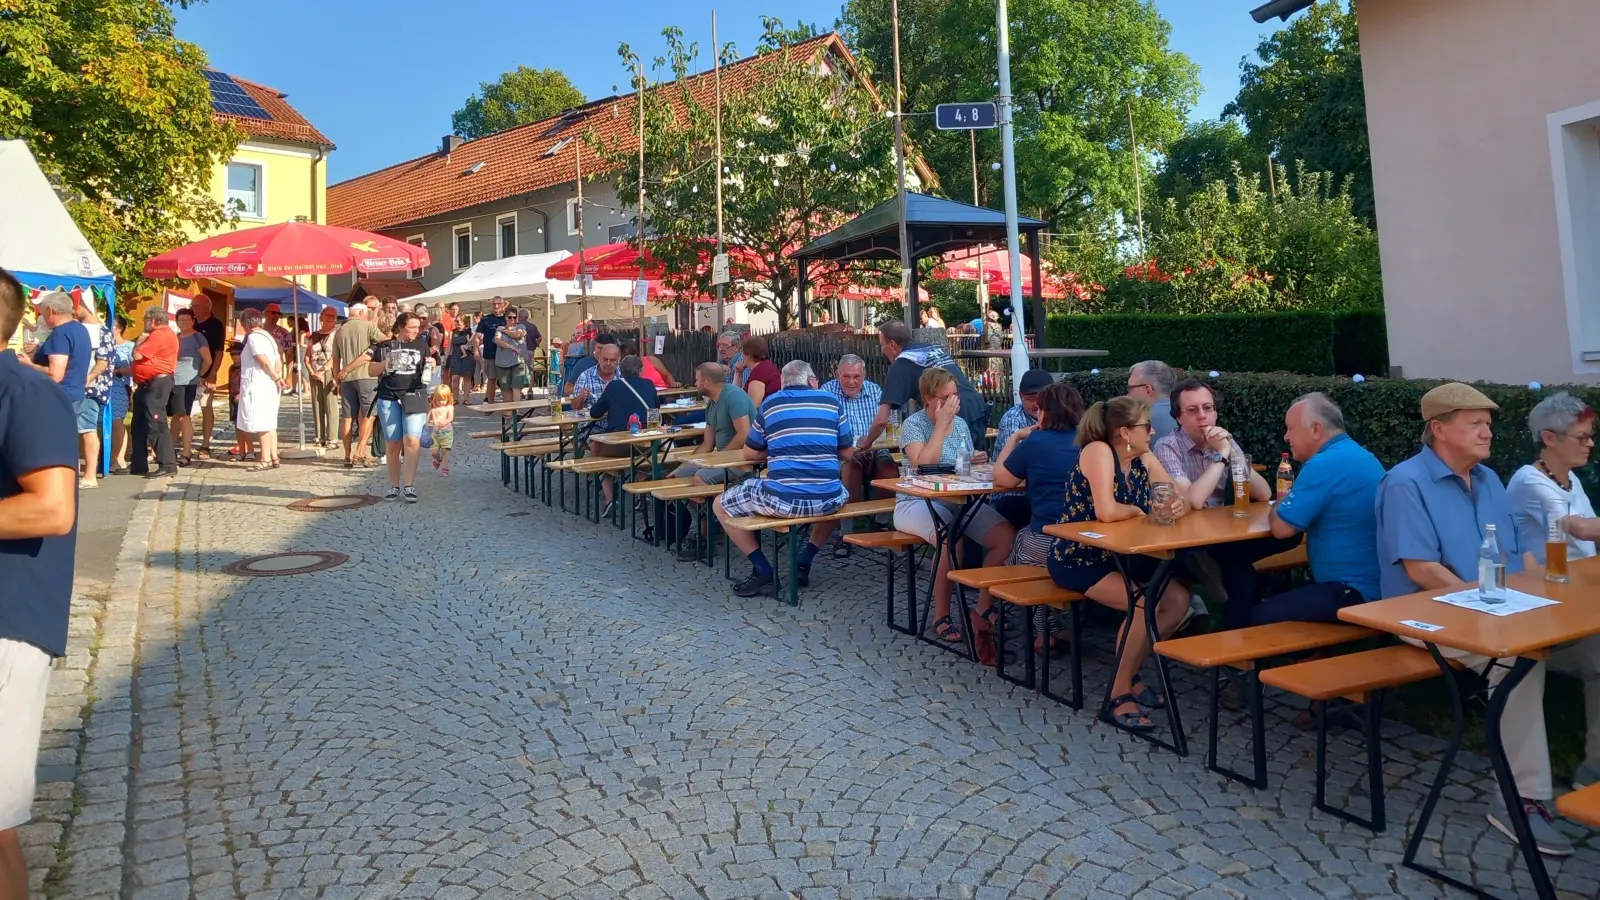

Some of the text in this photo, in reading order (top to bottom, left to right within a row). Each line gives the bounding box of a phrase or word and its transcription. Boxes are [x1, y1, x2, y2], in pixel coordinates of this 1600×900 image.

[971, 107, 979, 121] 8
[194, 262, 246, 274] Püttner Bräu
